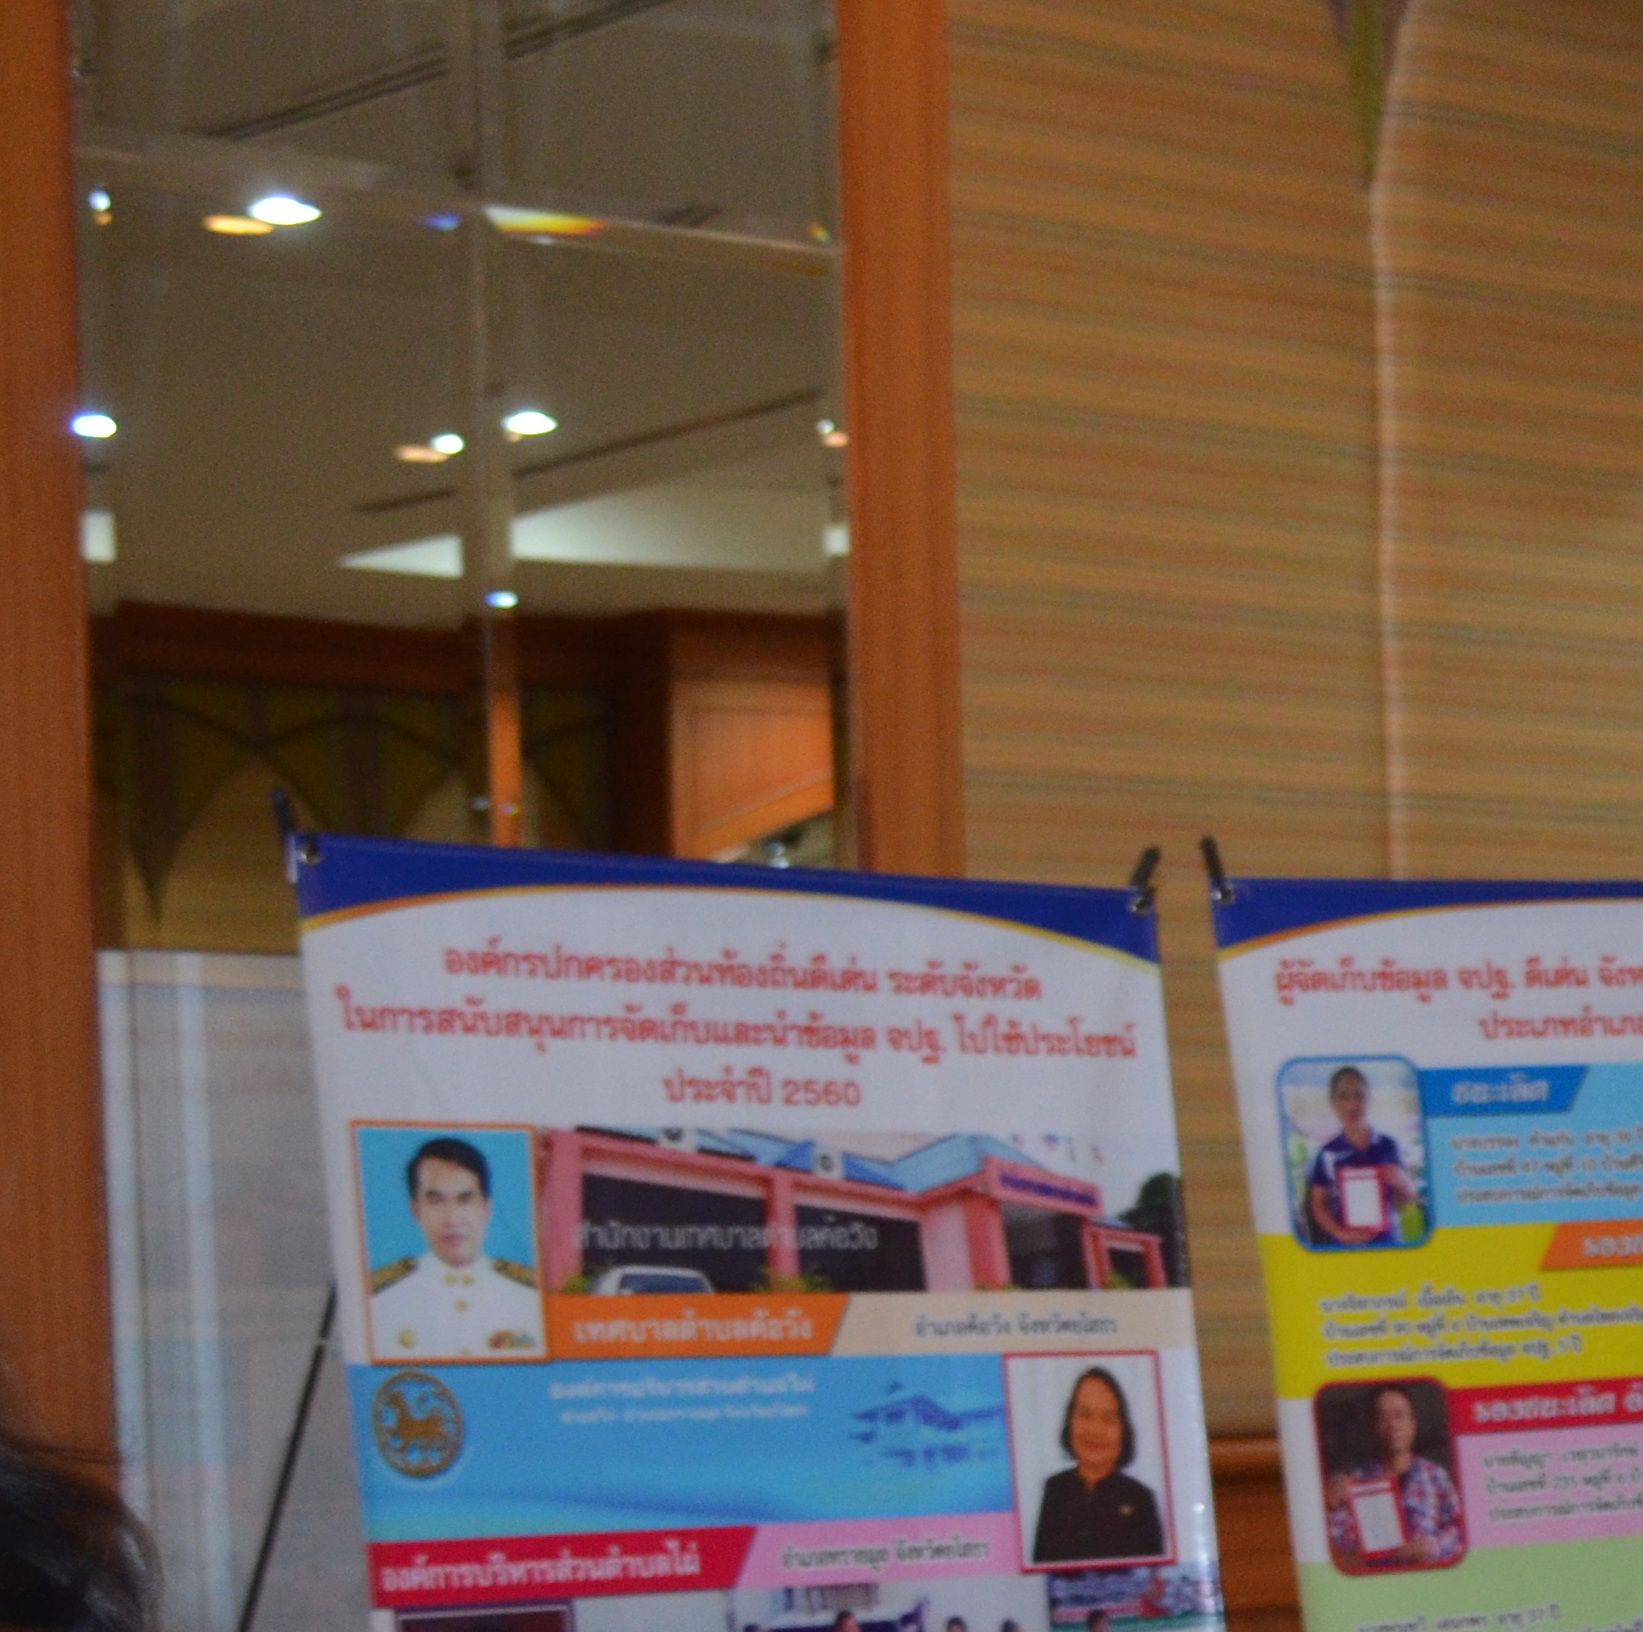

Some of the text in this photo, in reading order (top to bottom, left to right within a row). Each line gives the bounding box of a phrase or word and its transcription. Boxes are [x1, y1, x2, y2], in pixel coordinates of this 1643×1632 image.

[888, 960, 1043, 1000] ระดับจังหวัด
[1275, 956, 1448, 1006] ผู้จัดเก็บข้อมูล
[1524, 956, 1589, 989] ดีเด่น
[334, 985, 878, 1065] ในการสนับสนุนการจัดเก็บและนำข้อมูล
[951, 1012, 1138, 1058] ไปใช้ประโยชน์
[663, 1065, 861, 1108] ประจำปี 2560
